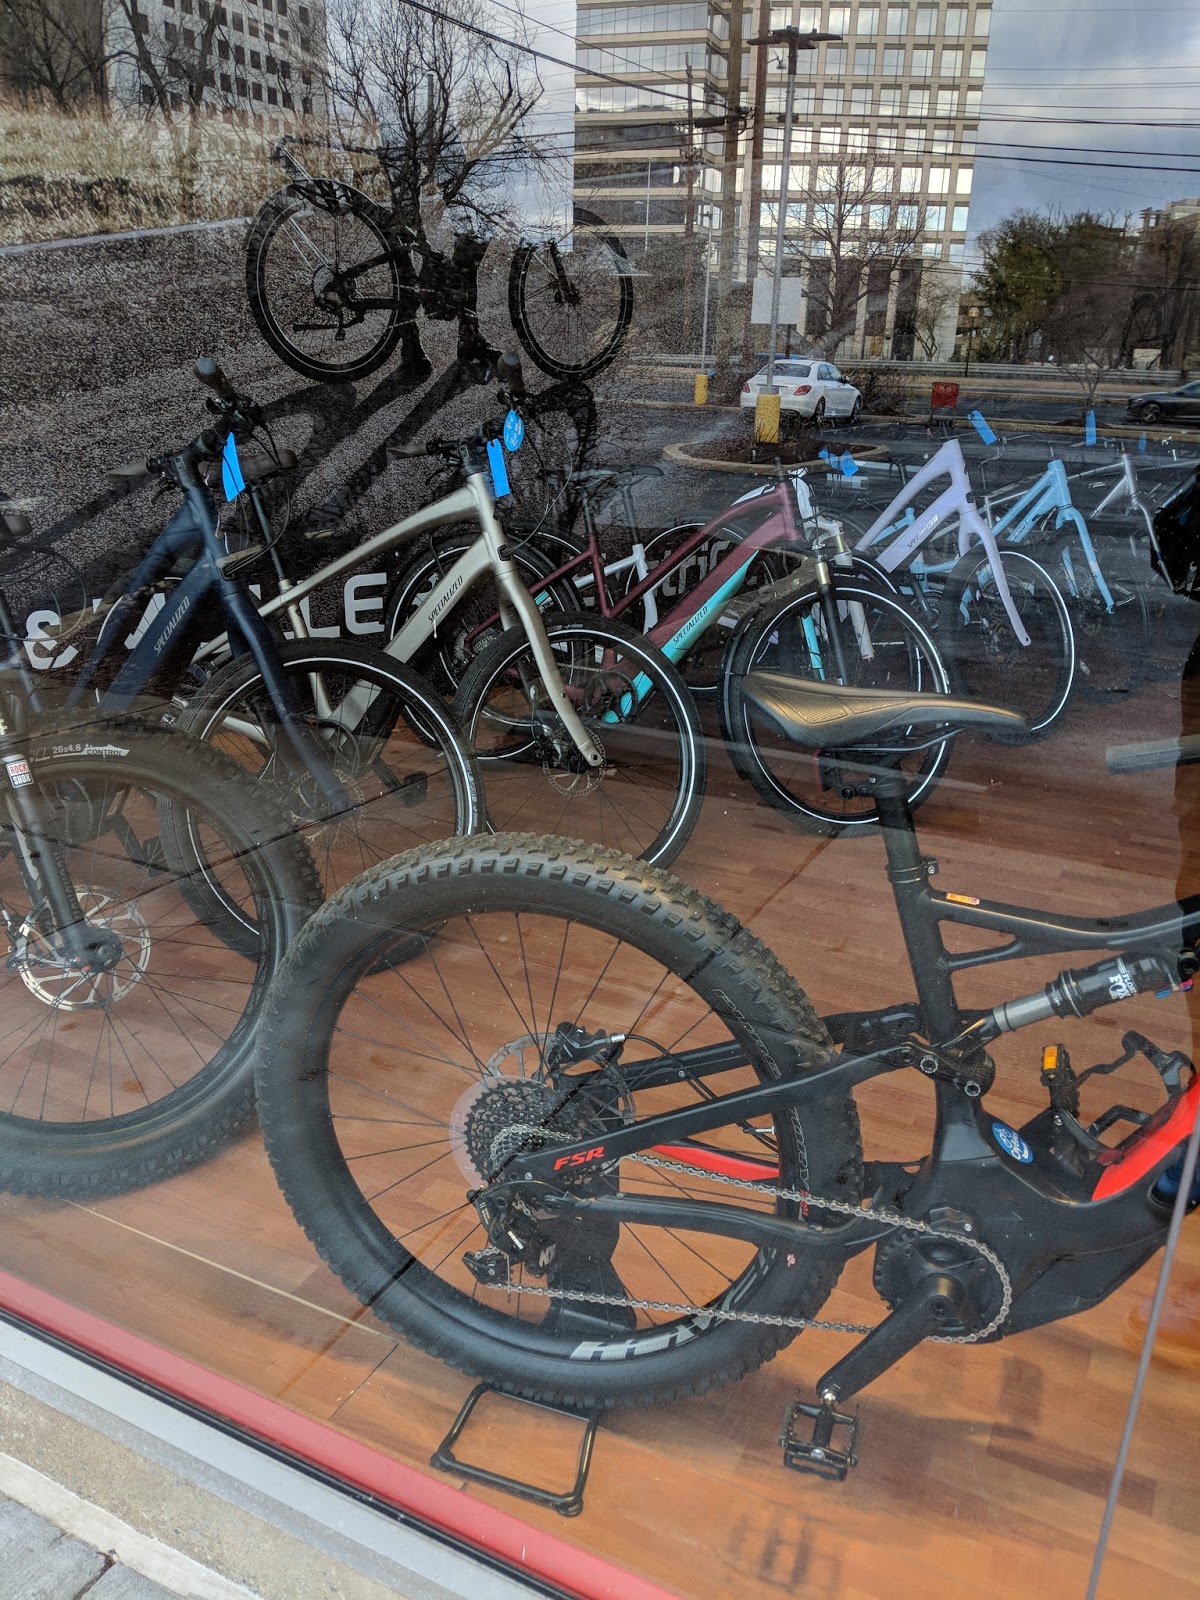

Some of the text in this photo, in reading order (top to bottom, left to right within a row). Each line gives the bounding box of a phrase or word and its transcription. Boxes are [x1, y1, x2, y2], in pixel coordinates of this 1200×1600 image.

[428, 575, 463, 626] SPECIALIZED
[153, 595, 191, 657] SPECIALIZED
[673, 605, 708, 645] SPECIALIZED
[52, 743, 82, 755] 26x4.6
[9, 761, 29, 775] ROCK
[1109, 973, 1132, 1000] FOX
[553, 1146, 606, 1171] FSR
